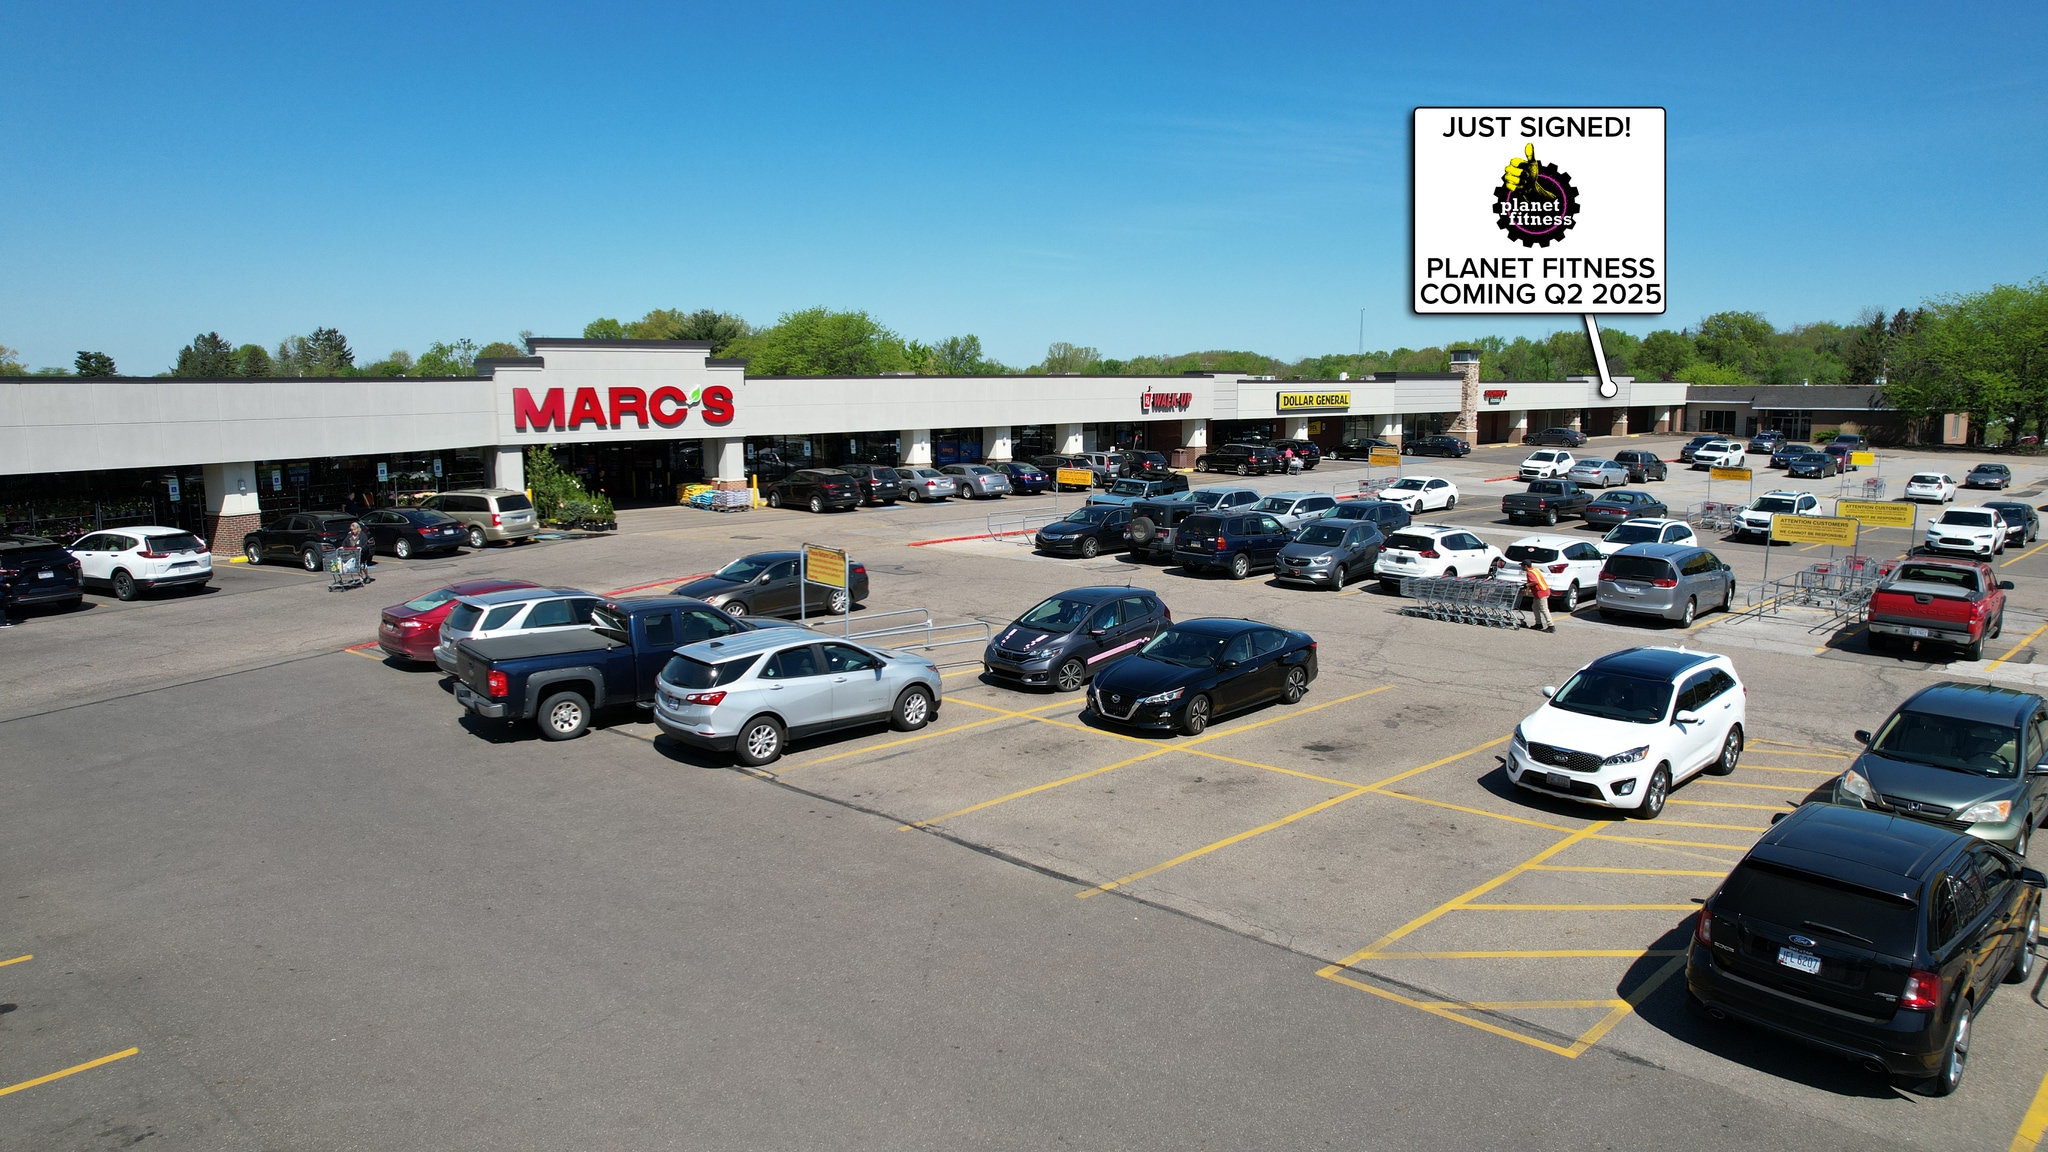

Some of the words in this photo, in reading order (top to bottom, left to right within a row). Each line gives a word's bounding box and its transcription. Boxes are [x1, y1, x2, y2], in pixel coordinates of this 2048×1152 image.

[1152, 392, 1193, 407] WALK-UP
[1283, 395, 1314, 406] DOLLAR
[1316, 394, 1349, 405] GENERAL
[513, 385, 735, 431] MARC'S
[1813, 520, 1849, 528] CUSTOMERS
[1780, 950, 1795, 964] JFL
[1797, 953, 1819, 969] 6207
